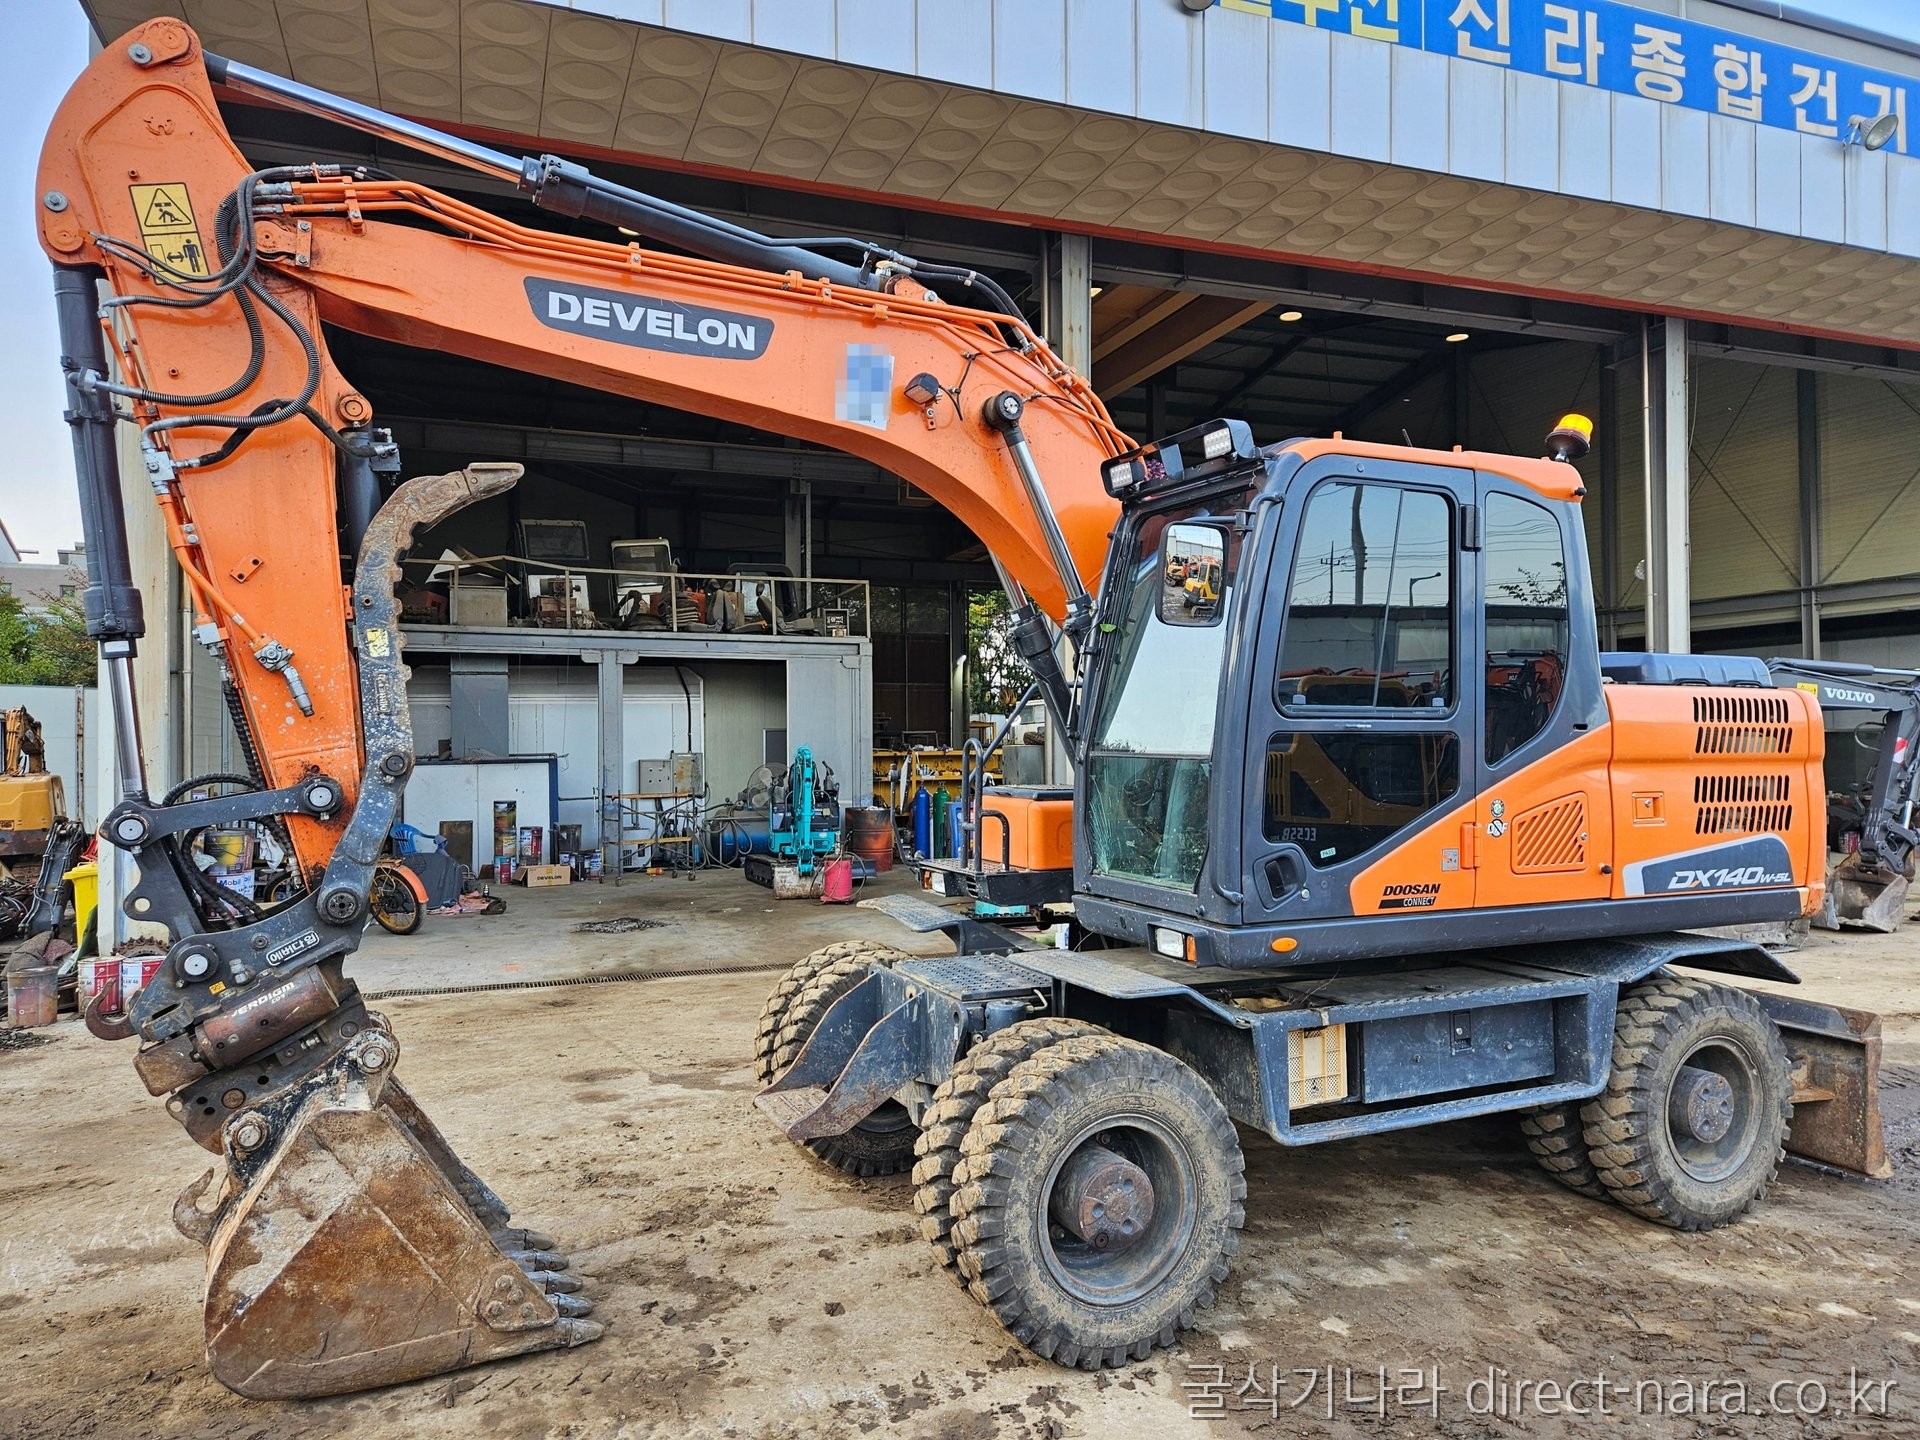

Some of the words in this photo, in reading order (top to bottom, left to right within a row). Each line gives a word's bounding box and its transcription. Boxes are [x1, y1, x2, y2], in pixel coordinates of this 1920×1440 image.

[548, 291, 755, 351] DEVELON
[1824, 687, 1875, 704] VOLVO
[1383, 883, 1441, 896] DOOSAN
[1403, 897, 1435, 907] CONNECT
[269, 933, 317, 962] 에버다임
